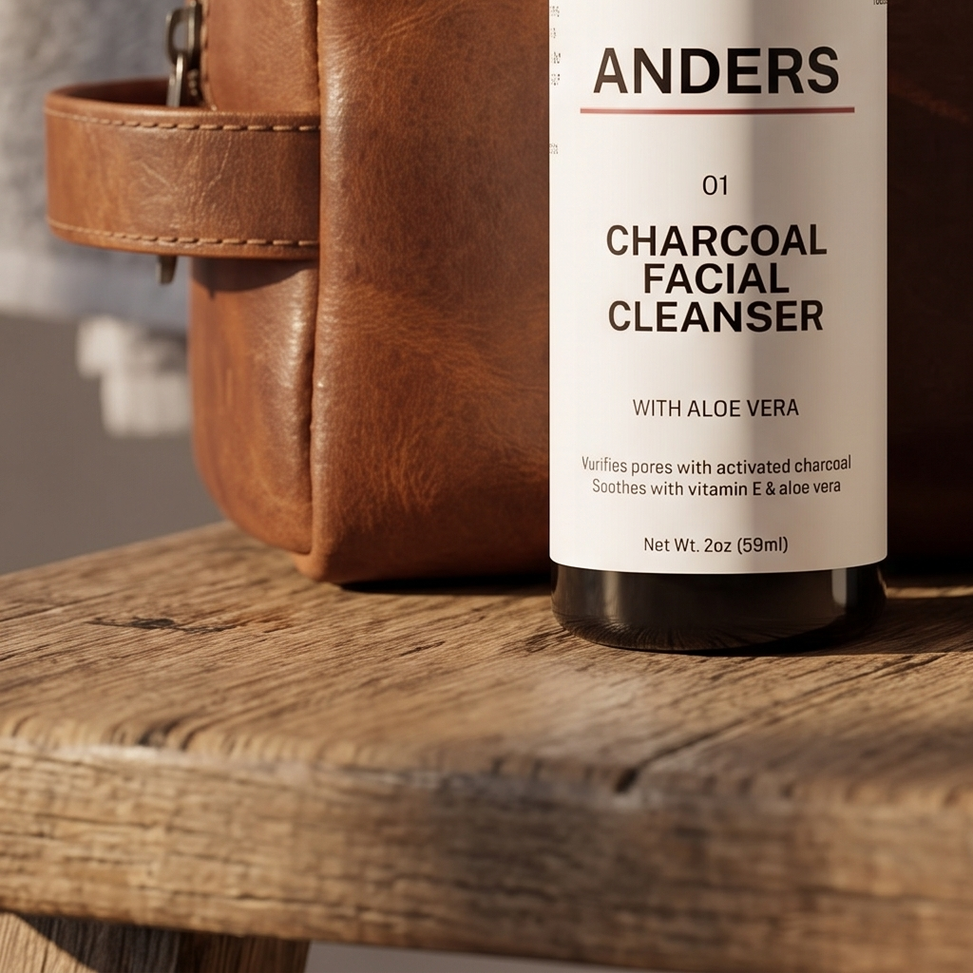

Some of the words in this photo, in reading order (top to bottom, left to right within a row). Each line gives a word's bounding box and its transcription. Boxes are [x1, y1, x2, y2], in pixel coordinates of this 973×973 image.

[593, 46, 839, 94] ANDERS
[702, 175, 728, 196] 01
[606, 224, 827, 257] CHARCOAL
[644, 263, 790, 294] FACIAL
[608, 300, 823, 333] CLEANSER
[632, 399, 681, 417] WITH
[687, 400, 741, 417] ALOE
[746, 399, 799, 417] VERA
[631, 461, 673, 477] pores
[677, 459, 712, 474] with
[716, 457, 791, 475] activated
[794, 454, 852, 473] charcoal
[592, 478, 647, 495] Soothes
[650, 480, 684, 496] with
[688, 480, 748, 496] vitamin
[752, 481, 762, 496] E
[765, 481, 776, 496] &
[779, 480, 810, 495] aloe
[813, 479, 842, 494] vera
[643, 537, 670, 553] Net
[674, 538, 700, 553] Wt.
[704, 538, 732, 553] 2oz
[736, 536, 789, 555] (59ml)
